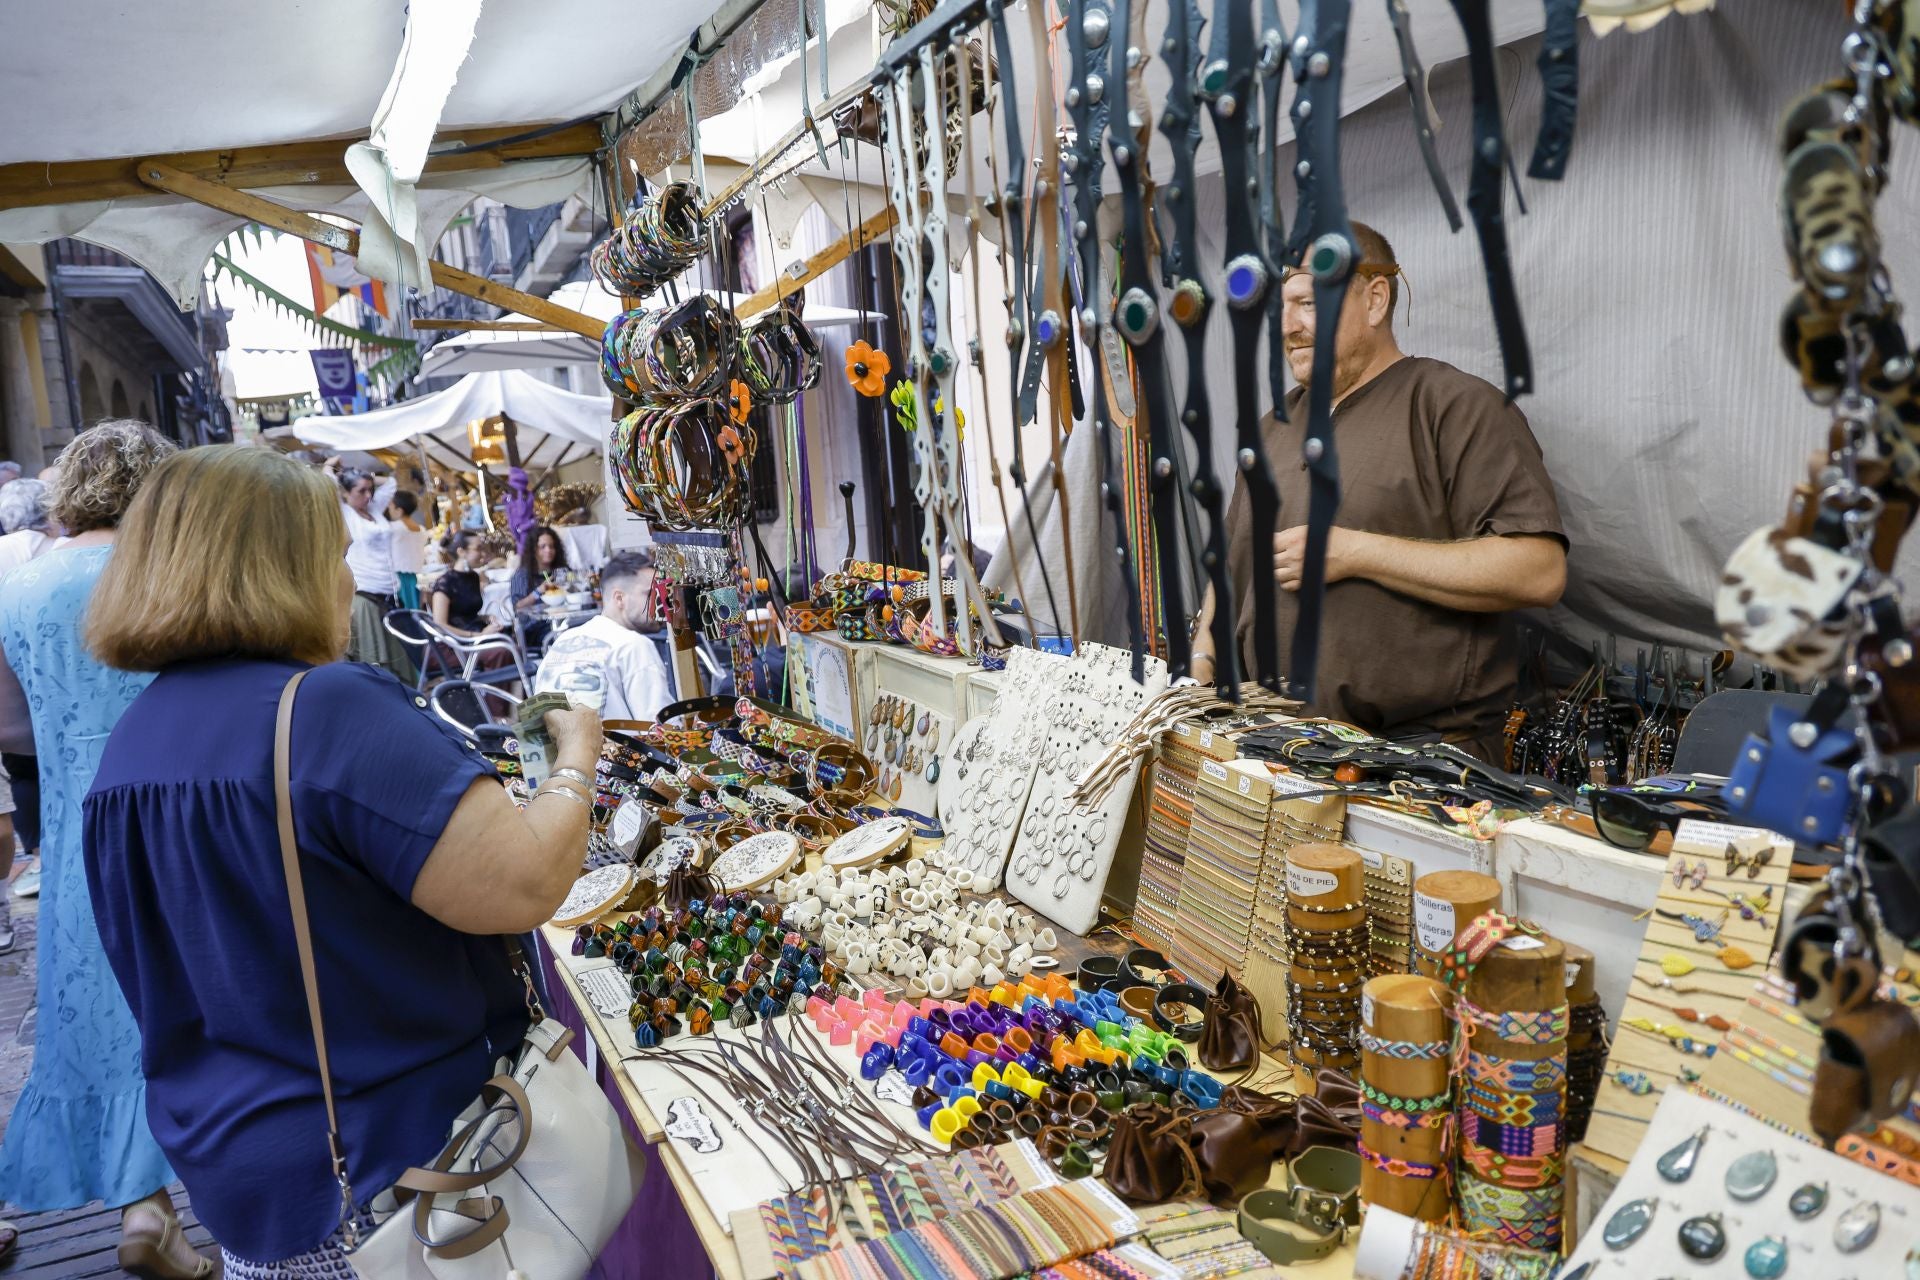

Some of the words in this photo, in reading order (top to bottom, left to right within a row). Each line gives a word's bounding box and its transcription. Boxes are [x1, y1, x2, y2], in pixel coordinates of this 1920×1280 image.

[523, 751, 542, 763] 5
[1390, 862, 1404, 877] 5€
[1302, 876, 1314, 885] DE
[1316, 878, 1337, 886] PIEL
[1416, 892, 1453, 913] Tobilleras
[1424, 935, 1437, 950] 5€
